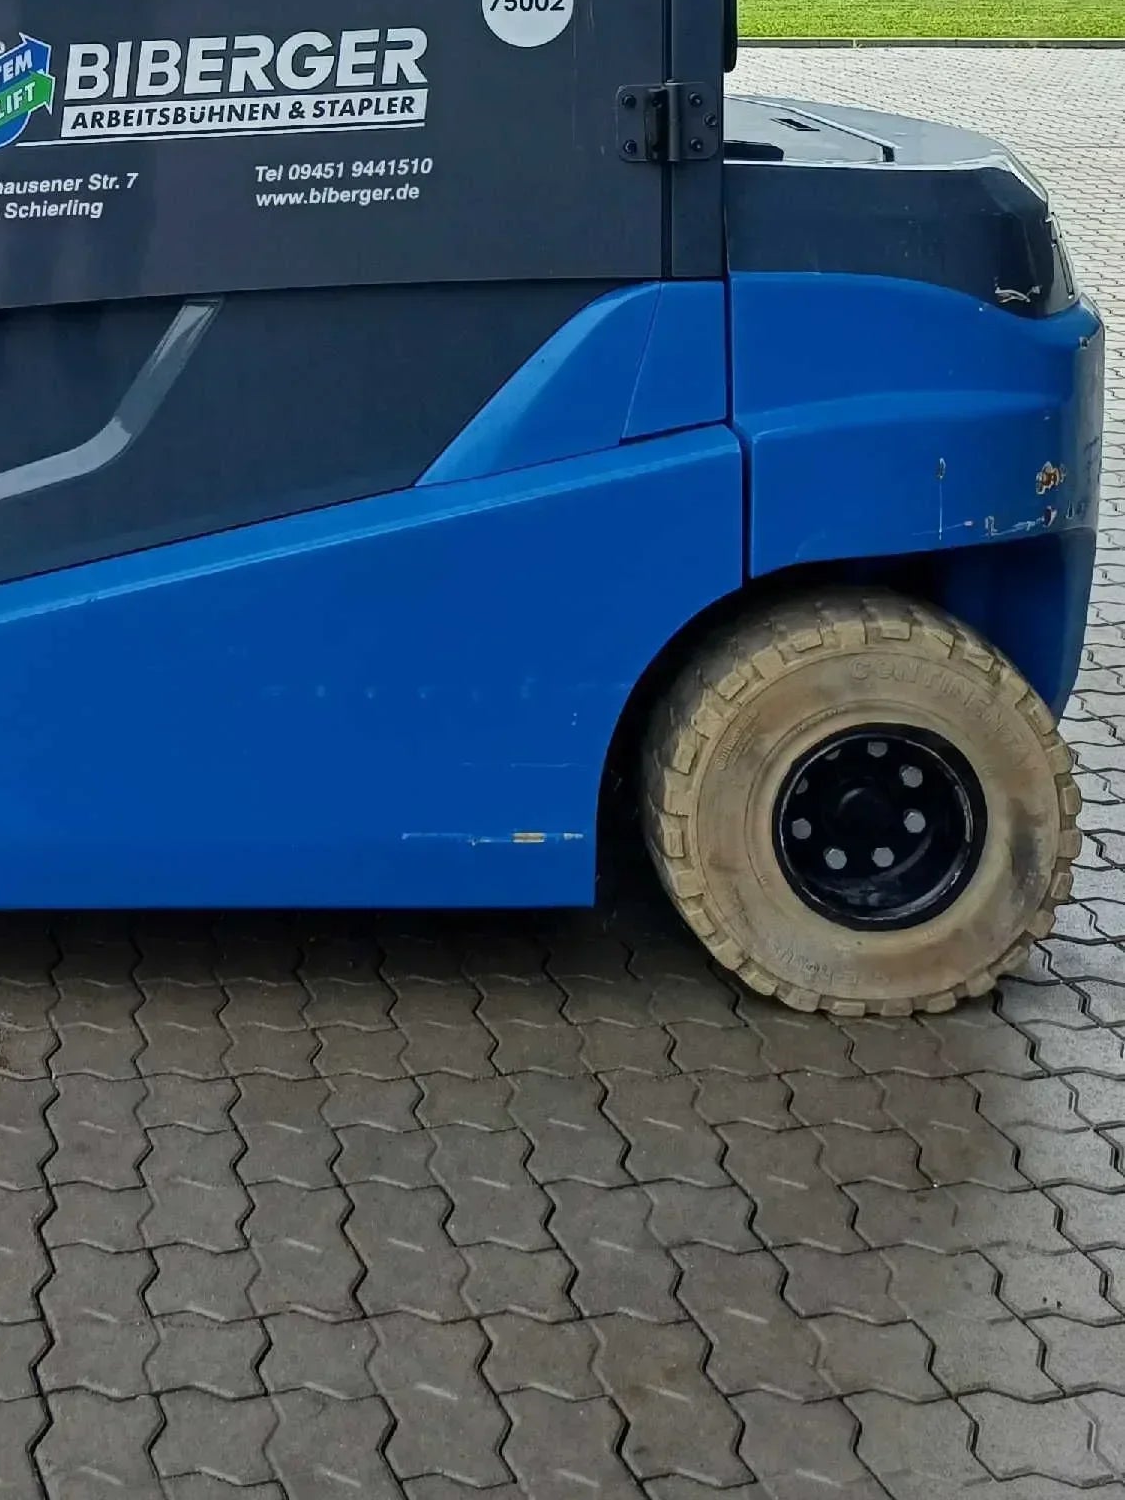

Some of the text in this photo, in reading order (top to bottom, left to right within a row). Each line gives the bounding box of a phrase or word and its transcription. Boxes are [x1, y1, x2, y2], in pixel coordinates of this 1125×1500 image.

[64, 28, 428, 101] BIBERGER
[71, 96, 415, 130] ARBEITSBÜHNEN & STAPLER
[88, 173, 120, 191] Str.
[126, 172, 139, 189] 7
[255, 157, 434, 182] Tel 09451 9441510
[255, 183, 420, 207] www.biberger.de
[4, 199, 104, 219] Schierling
